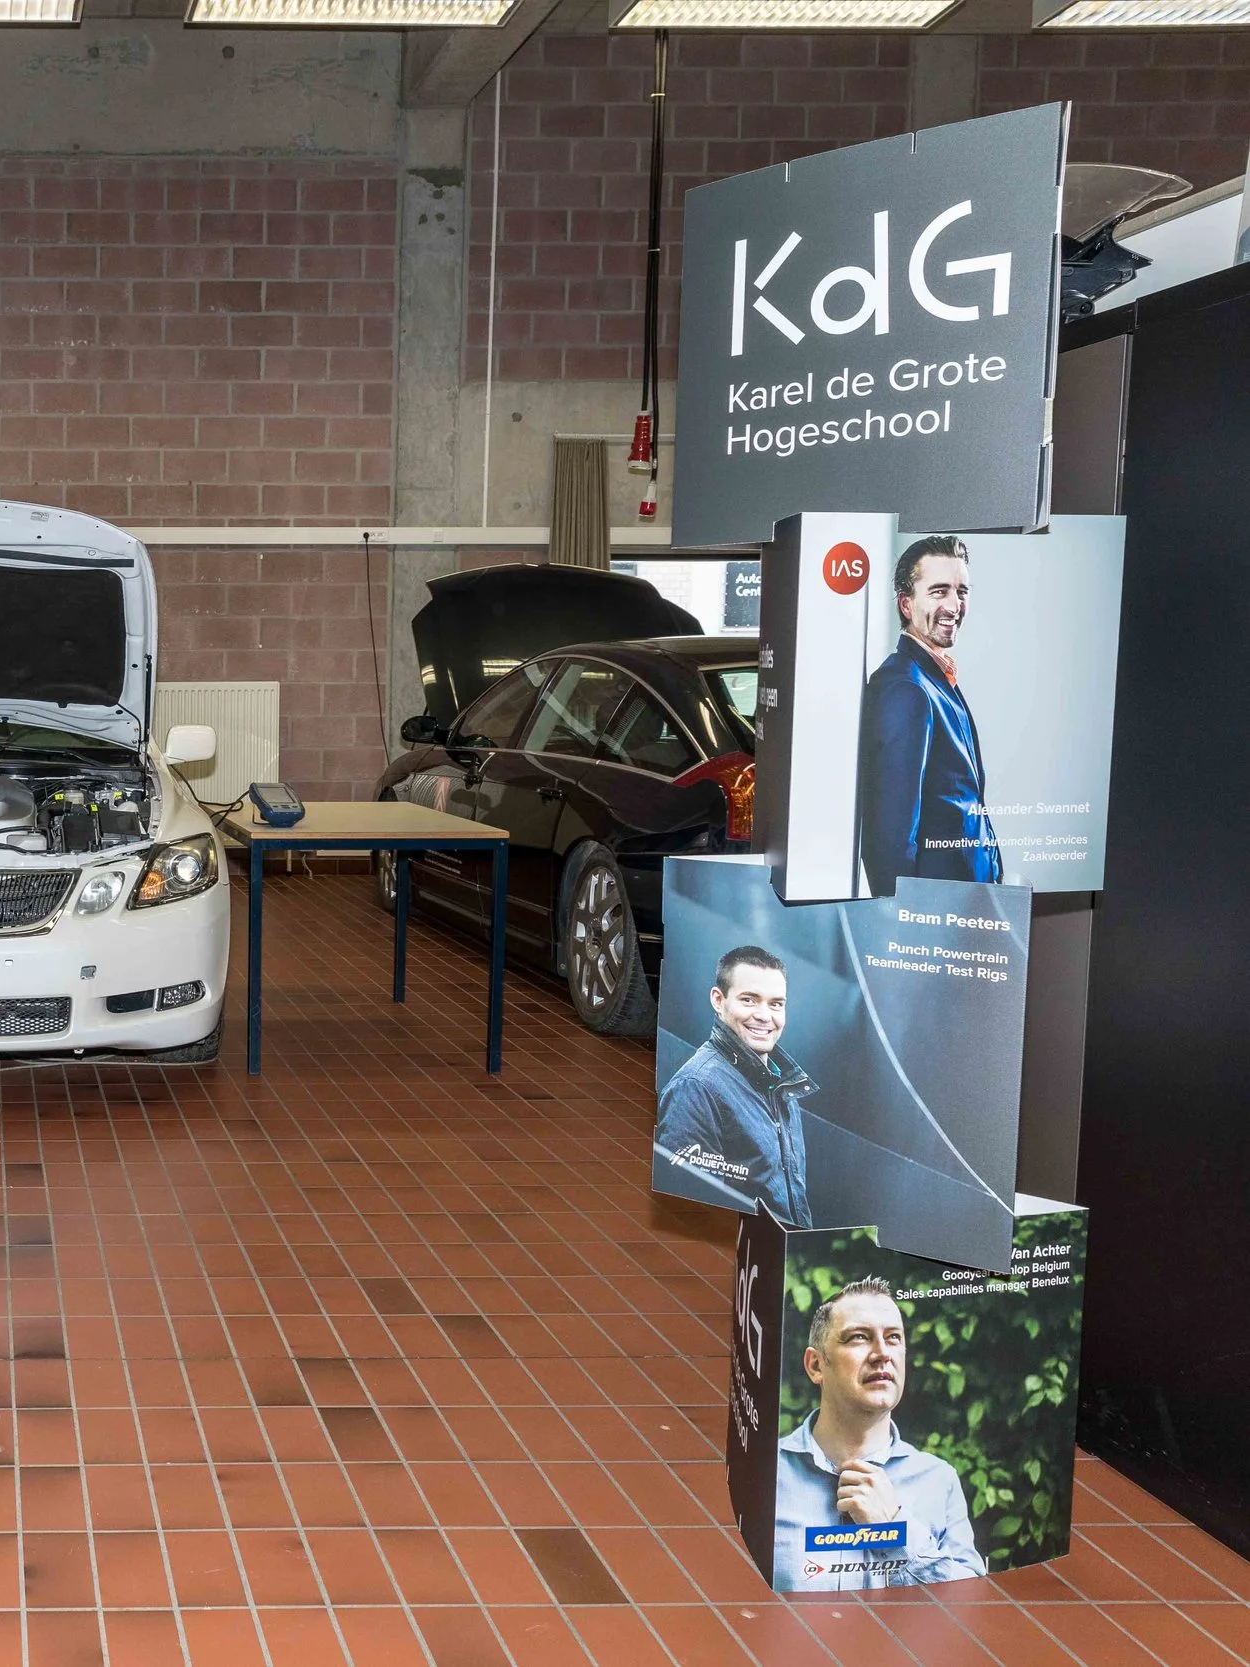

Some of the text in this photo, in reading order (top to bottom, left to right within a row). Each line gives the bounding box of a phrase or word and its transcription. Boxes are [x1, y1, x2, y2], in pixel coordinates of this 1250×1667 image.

[730, 199, 1013, 357] KdG
[726, 352, 1008, 414] Karel de Grote
[726, 401, 951, 458] Hogeschool
[831, 558, 864, 578] IAS
[967, 801, 1091, 816] Alexander Swannet
[925, 834, 1088, 849] Innovative Automotive Services
[1022, 851, 1088, 862] Zaakvoerder
[898, 909, 1011, 931] Bram Peeters
[888, 941, 1009, 964] Punch Powertrain
[865, 955, 1008, 983] Teamleader Test Rigs
[702, 1152, 725, 1162] punch
[1032, 1244, 1072, 1259] Achter
[1032, 1260, 1070, 1275] Belgium
[896, 1274, 1070, 1300] Sales capabilities manager Benelux
[740, 1372, 759, 1431] Grote
[814, 1528, 899, 1546] GOODYEAR
[828, 1559, 908, 1573] DUNLOP
